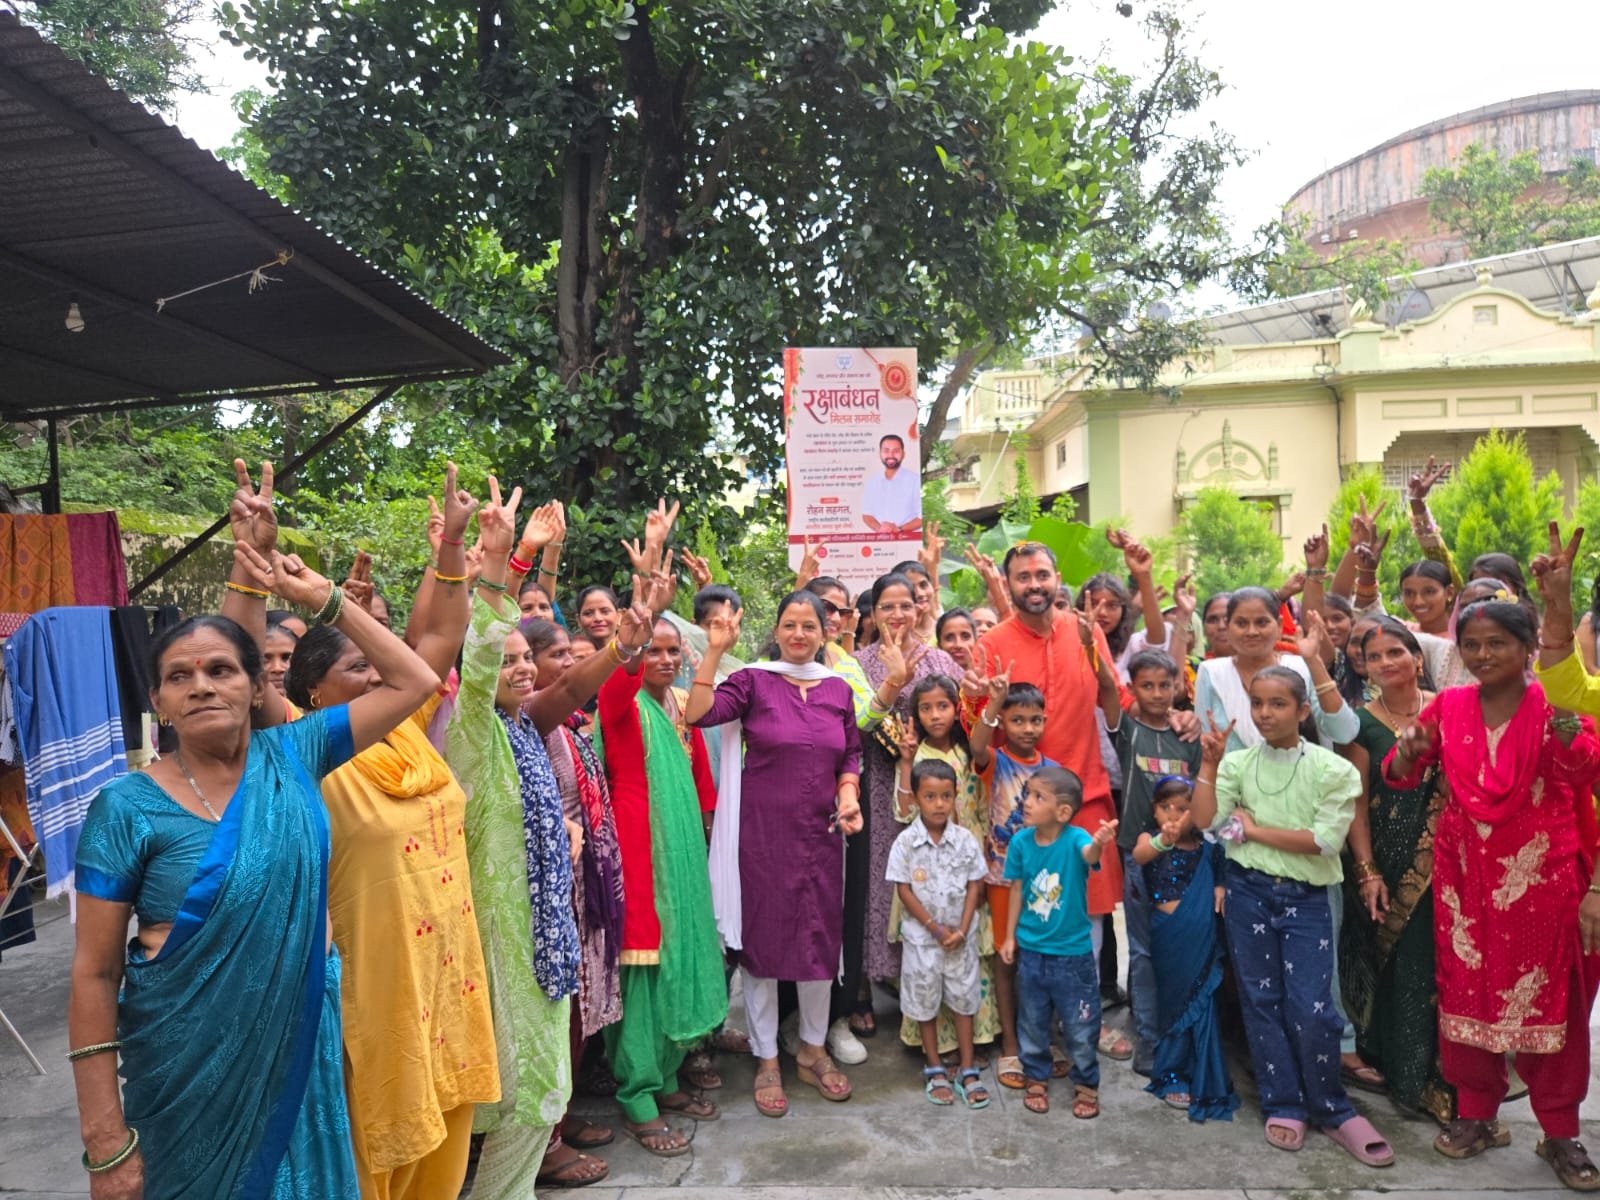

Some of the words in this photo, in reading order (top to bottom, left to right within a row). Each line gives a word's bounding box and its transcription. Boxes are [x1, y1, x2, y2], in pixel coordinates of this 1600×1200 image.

[801, 384, 881, 425] रक्षाबंधन
[830, 412, 852, 425] मिलन
[854, 411, 881, 425] समारोह
